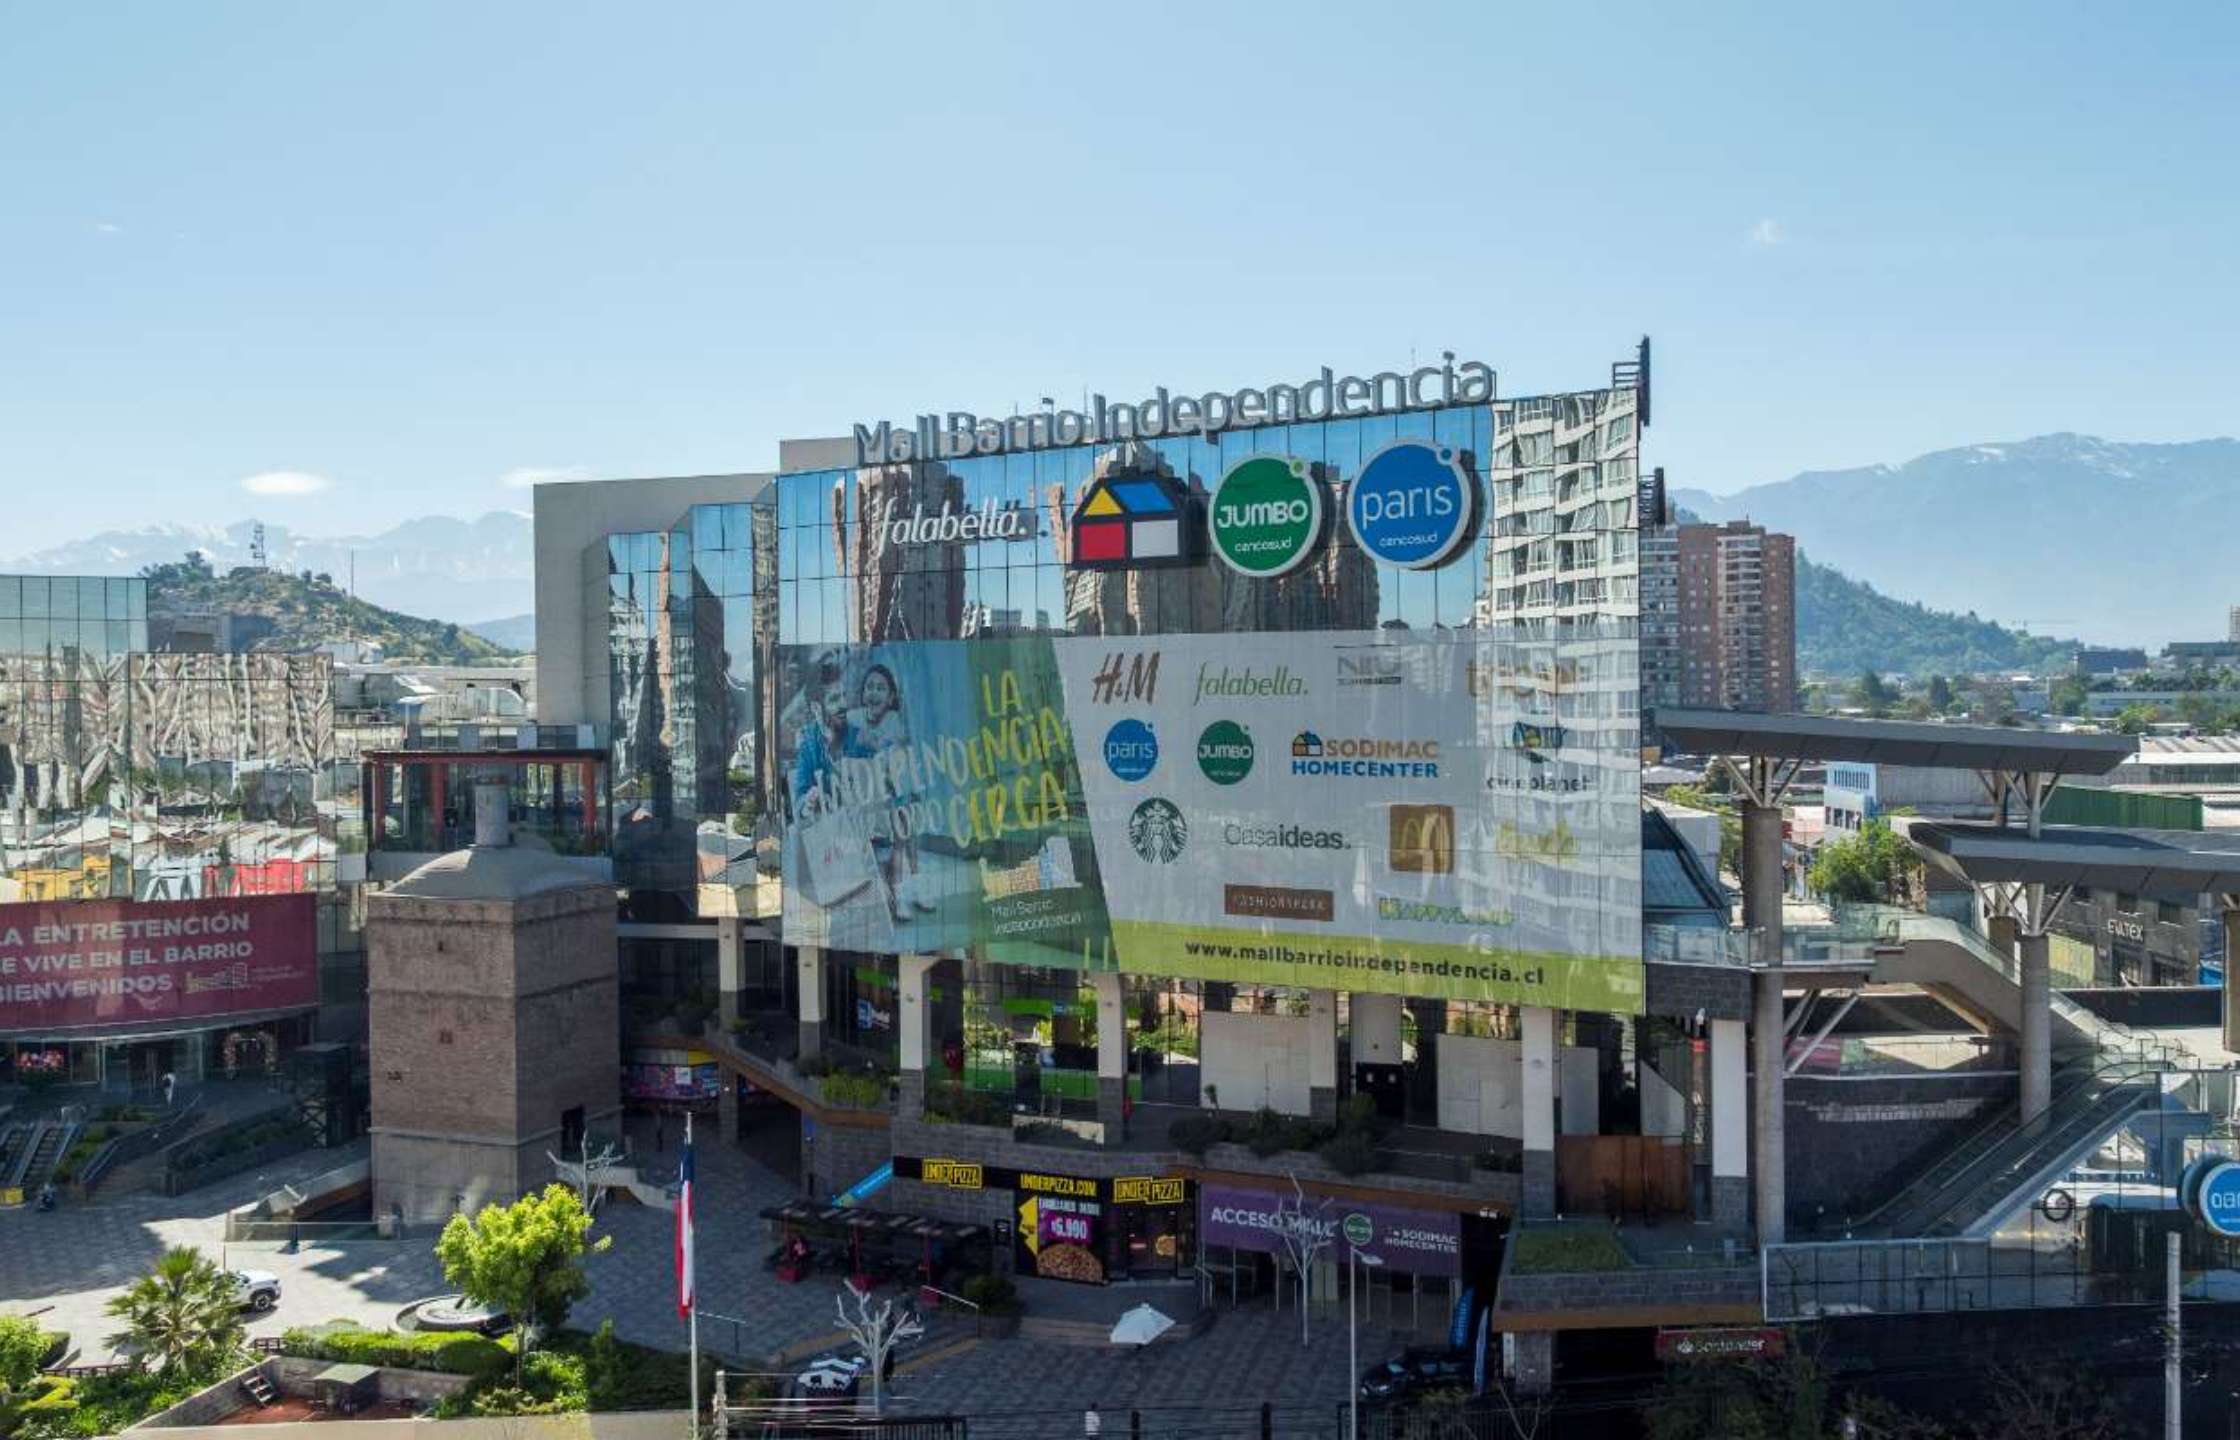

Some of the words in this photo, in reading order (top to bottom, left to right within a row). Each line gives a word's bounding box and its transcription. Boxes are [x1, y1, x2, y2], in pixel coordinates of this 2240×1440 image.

[852, 412, 940, 465] Mall
[946, 408, 1086, 456] Barrio
[1092, 350, 1494, 442] Independencia
[1217, 499, 1309, 529] JUMBO
[1361, 485, 1453, 530] paris
[1235, 536, 1292, 552] cencosud
[1379, 532, 1438, 547] cencosud
[981, 669, 1023, 719] LA
[1107, 741, 1155, 763] paris
[1326, 738, 1440, 760] SODIMAC
[1291, 759, 1440, 779] HOMECENTER
[33, 911, 250, 945] ENTRETENCIÓN
[25, 951, 84, 974] VIVE
[90, 951, 122, 969] EN
[129, 948, 157, 967] EL
[164, 940, 253, 964] BARRIO
[1185, 941, 1544, 985] www.mallbarrioindependencia.cl
[1211, 1207, 1283, 1229] ACCESO
